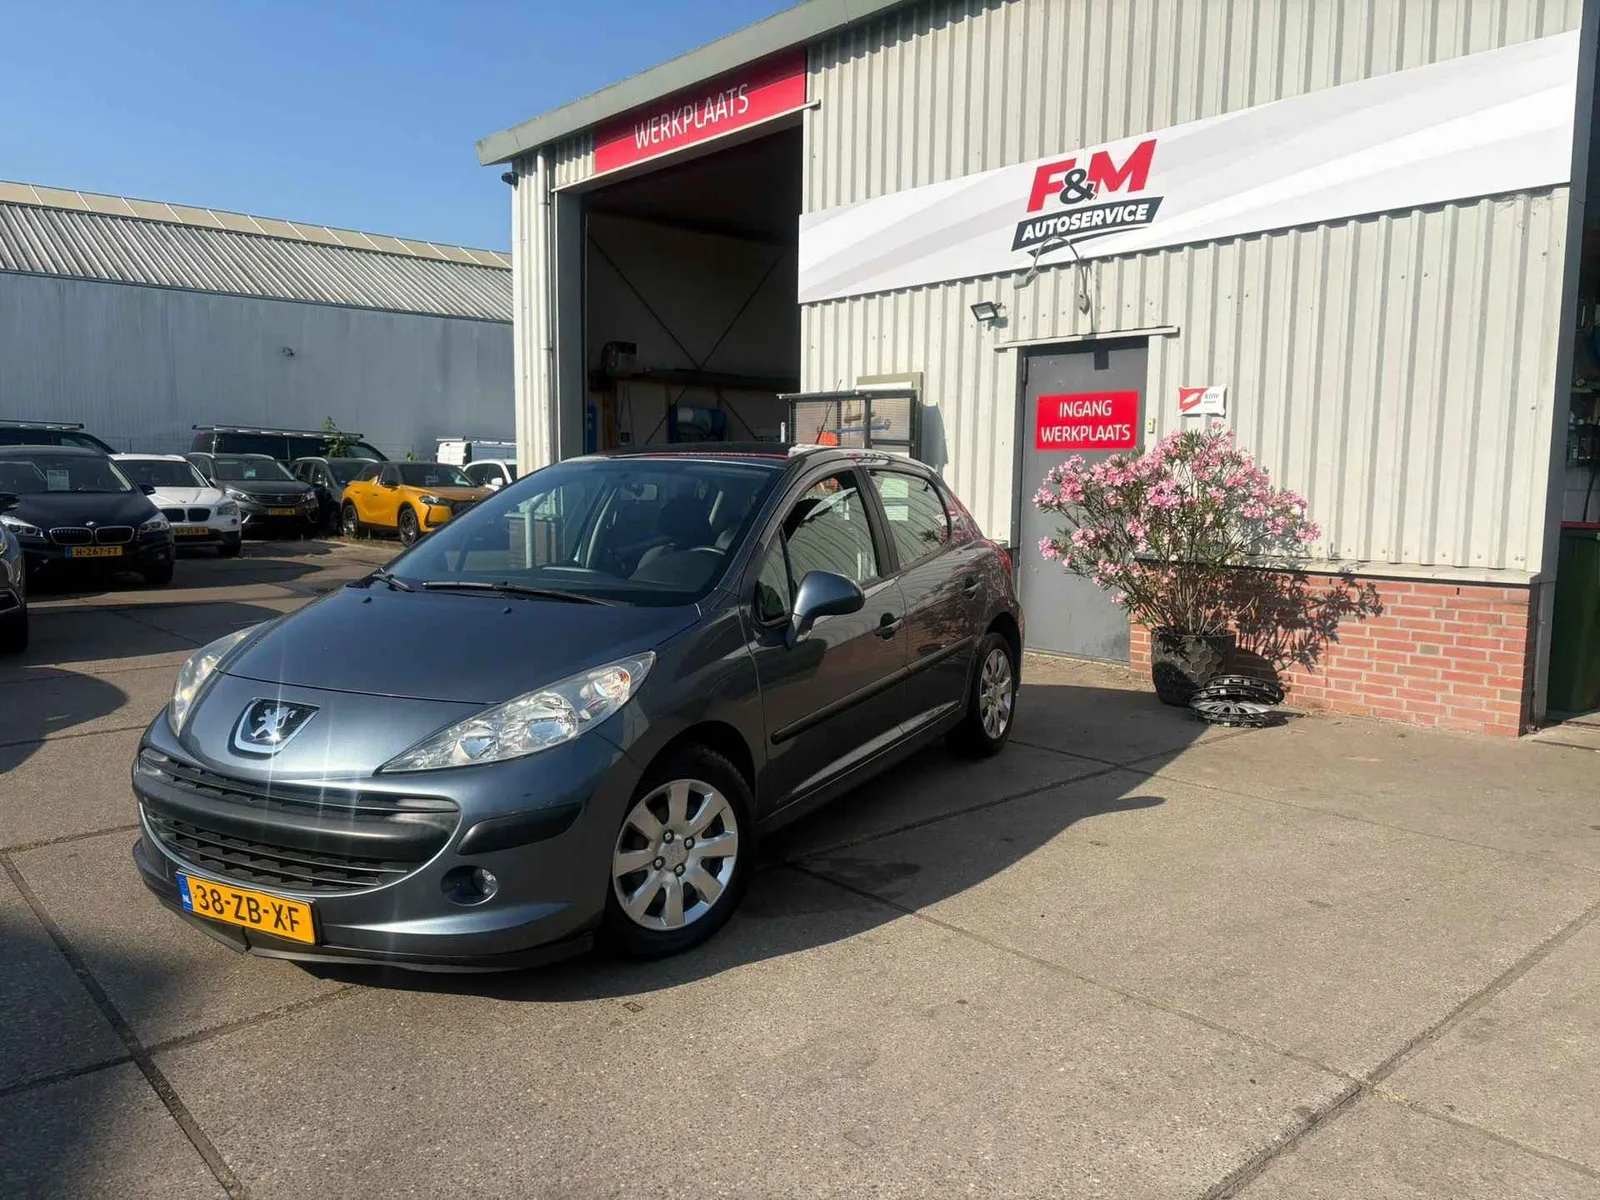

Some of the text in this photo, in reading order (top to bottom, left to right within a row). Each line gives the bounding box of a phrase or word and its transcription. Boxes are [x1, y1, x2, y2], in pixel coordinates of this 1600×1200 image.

[634, 83, 749, 149] WERKPLAATS
[1026, 138, 1157, 213] F&M
[1021, 203, 1150, 242] AUTOSERVICE
[1059, 400, 1113, 418] INGANG
[1041, 424, 1131, 443] WERKPLAATS
[75, 547, 120, 556] H-267-FT
[196, 884, 300, 932] 38-ZB-XF
